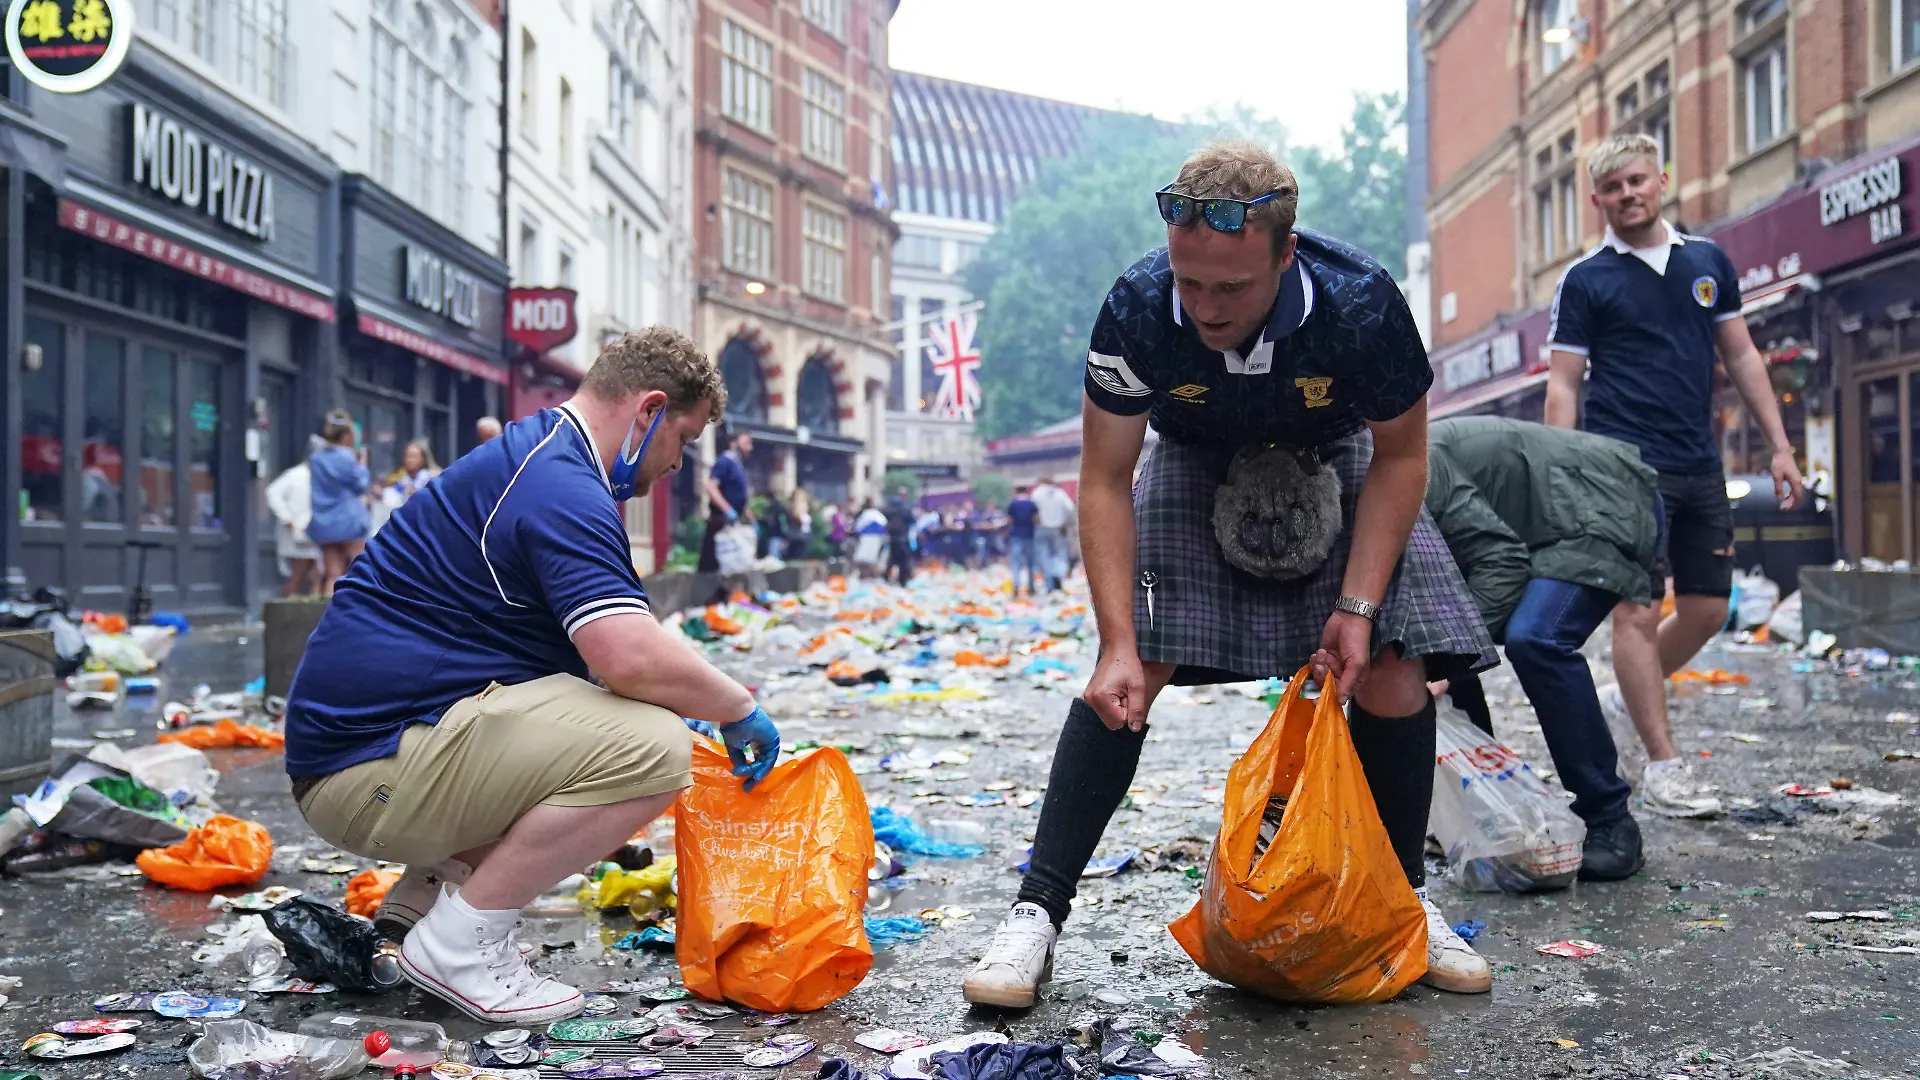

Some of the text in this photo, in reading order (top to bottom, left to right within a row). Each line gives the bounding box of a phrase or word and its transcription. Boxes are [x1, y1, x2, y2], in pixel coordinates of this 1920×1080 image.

[133, 102, 275, 243] MOD PIZZA
[1820, 155, 1901, 226] ESPRESSO
[74, 208, 226, 278] SUPERFAST
[1870, 204, 1902, 244] BAR
[406, 244, 443, 313] MOD
[443, 262, 480, 329] PIZZA
[511, 298, 567, 331] MOD
